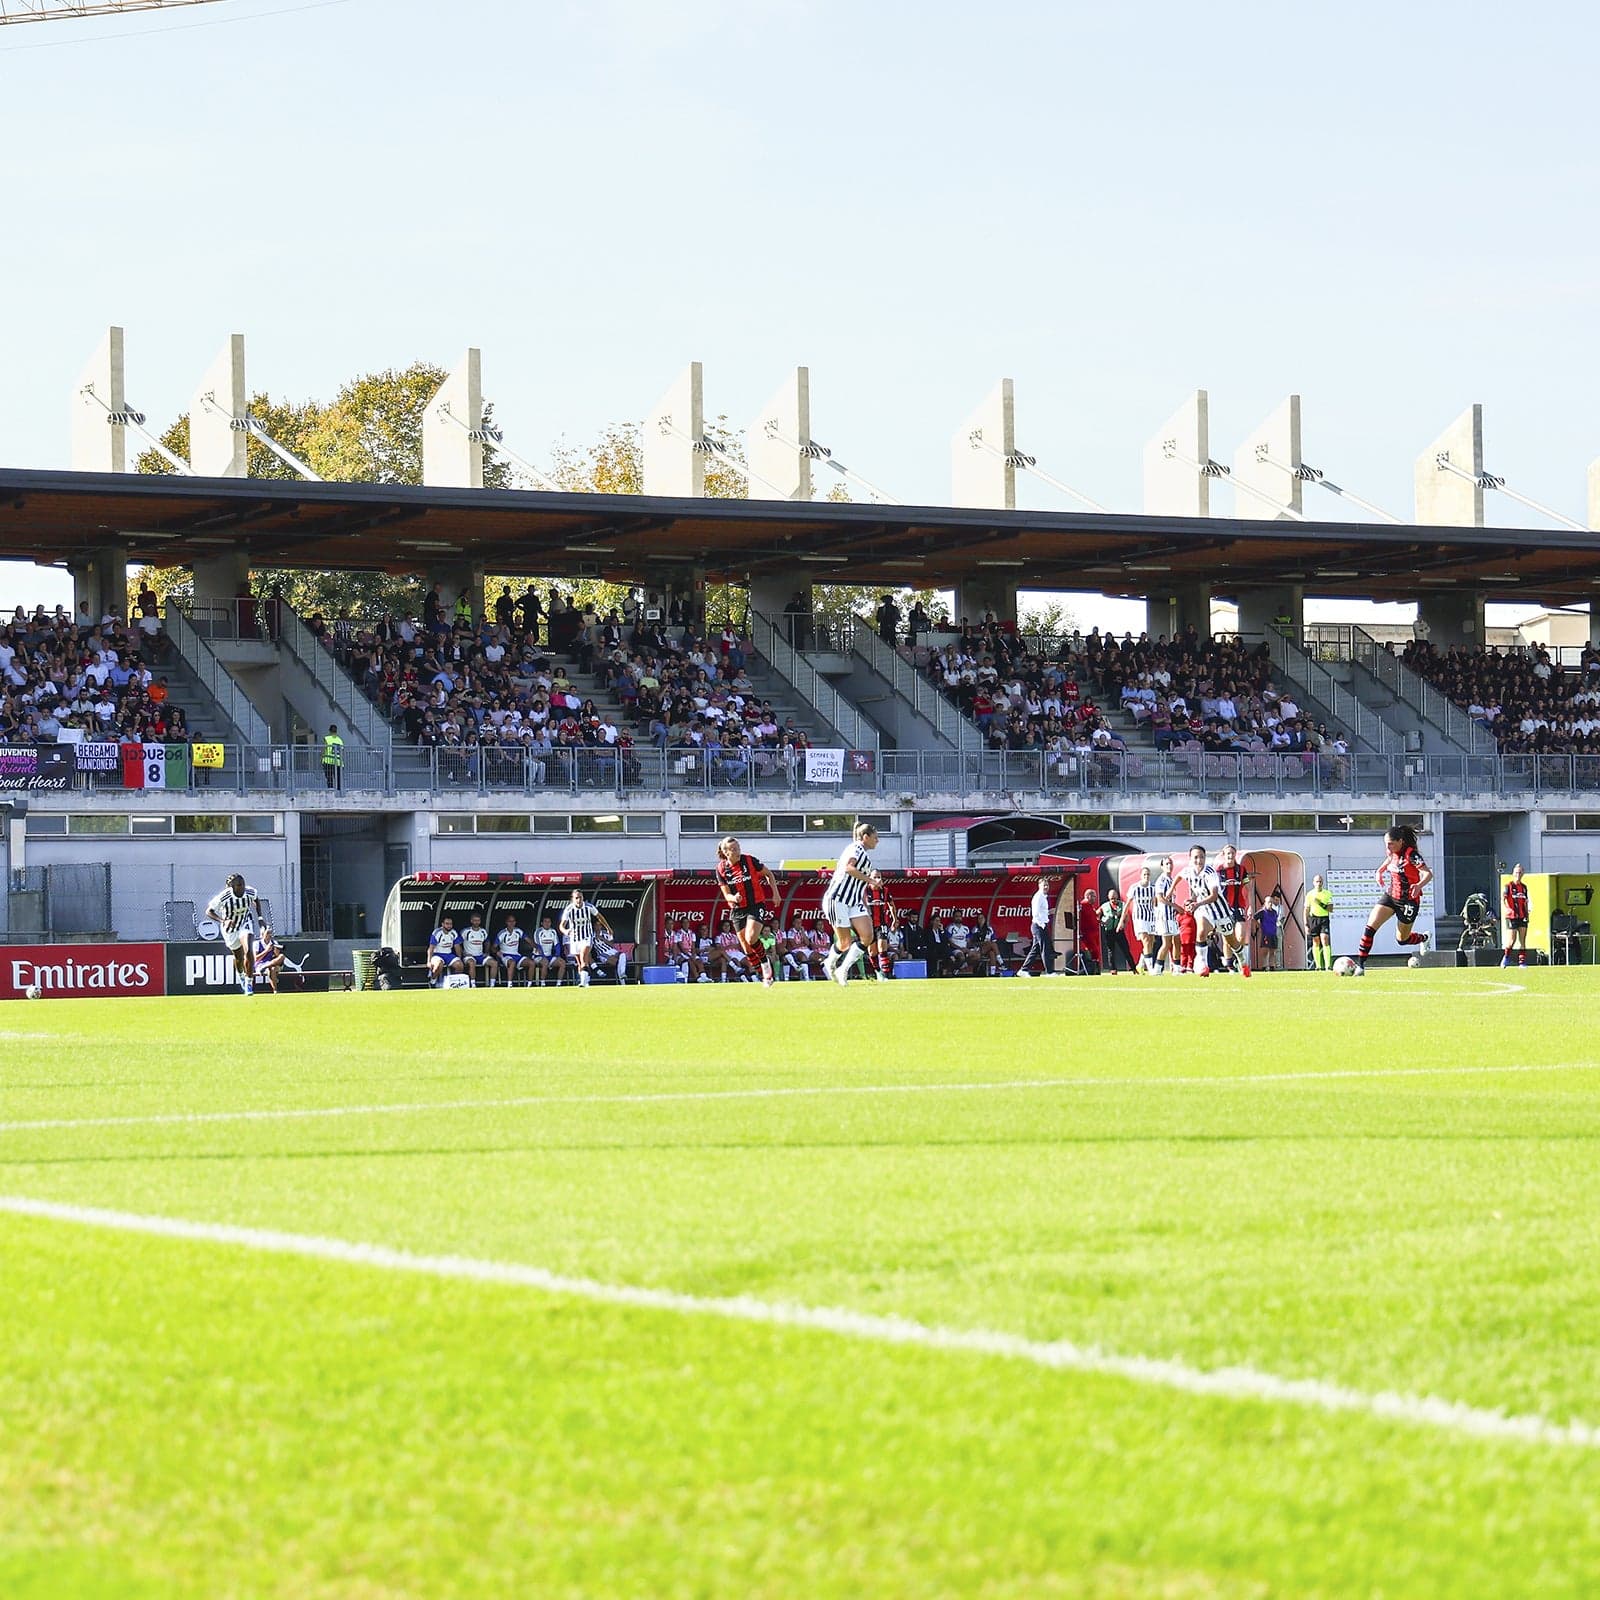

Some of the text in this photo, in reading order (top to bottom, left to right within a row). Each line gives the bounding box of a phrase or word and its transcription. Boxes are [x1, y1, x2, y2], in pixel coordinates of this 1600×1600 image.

[78, 744, 116, 757] BERGAMO
[77, 758, 117, 769] BIANCONERA
[149, 764, 160, 782] 8
[811, 768, 840, 778] SOFFIA
[0, 775, 66, 789] bout Heart
[400, 900, 424, 911] UMA
[444, 901, 475, 910] PUMA
[495, 900, 526, 910] PUMA
[545, 899, 570, 909] PUM
[595, 899, 626, 908] PUMA
[997, 905, 1032, 917] Emira
[1403, 904, 1414, 916] 15
[1220, 922, 1233, 933] 30
[11, 959, 149, 990] Emirates
